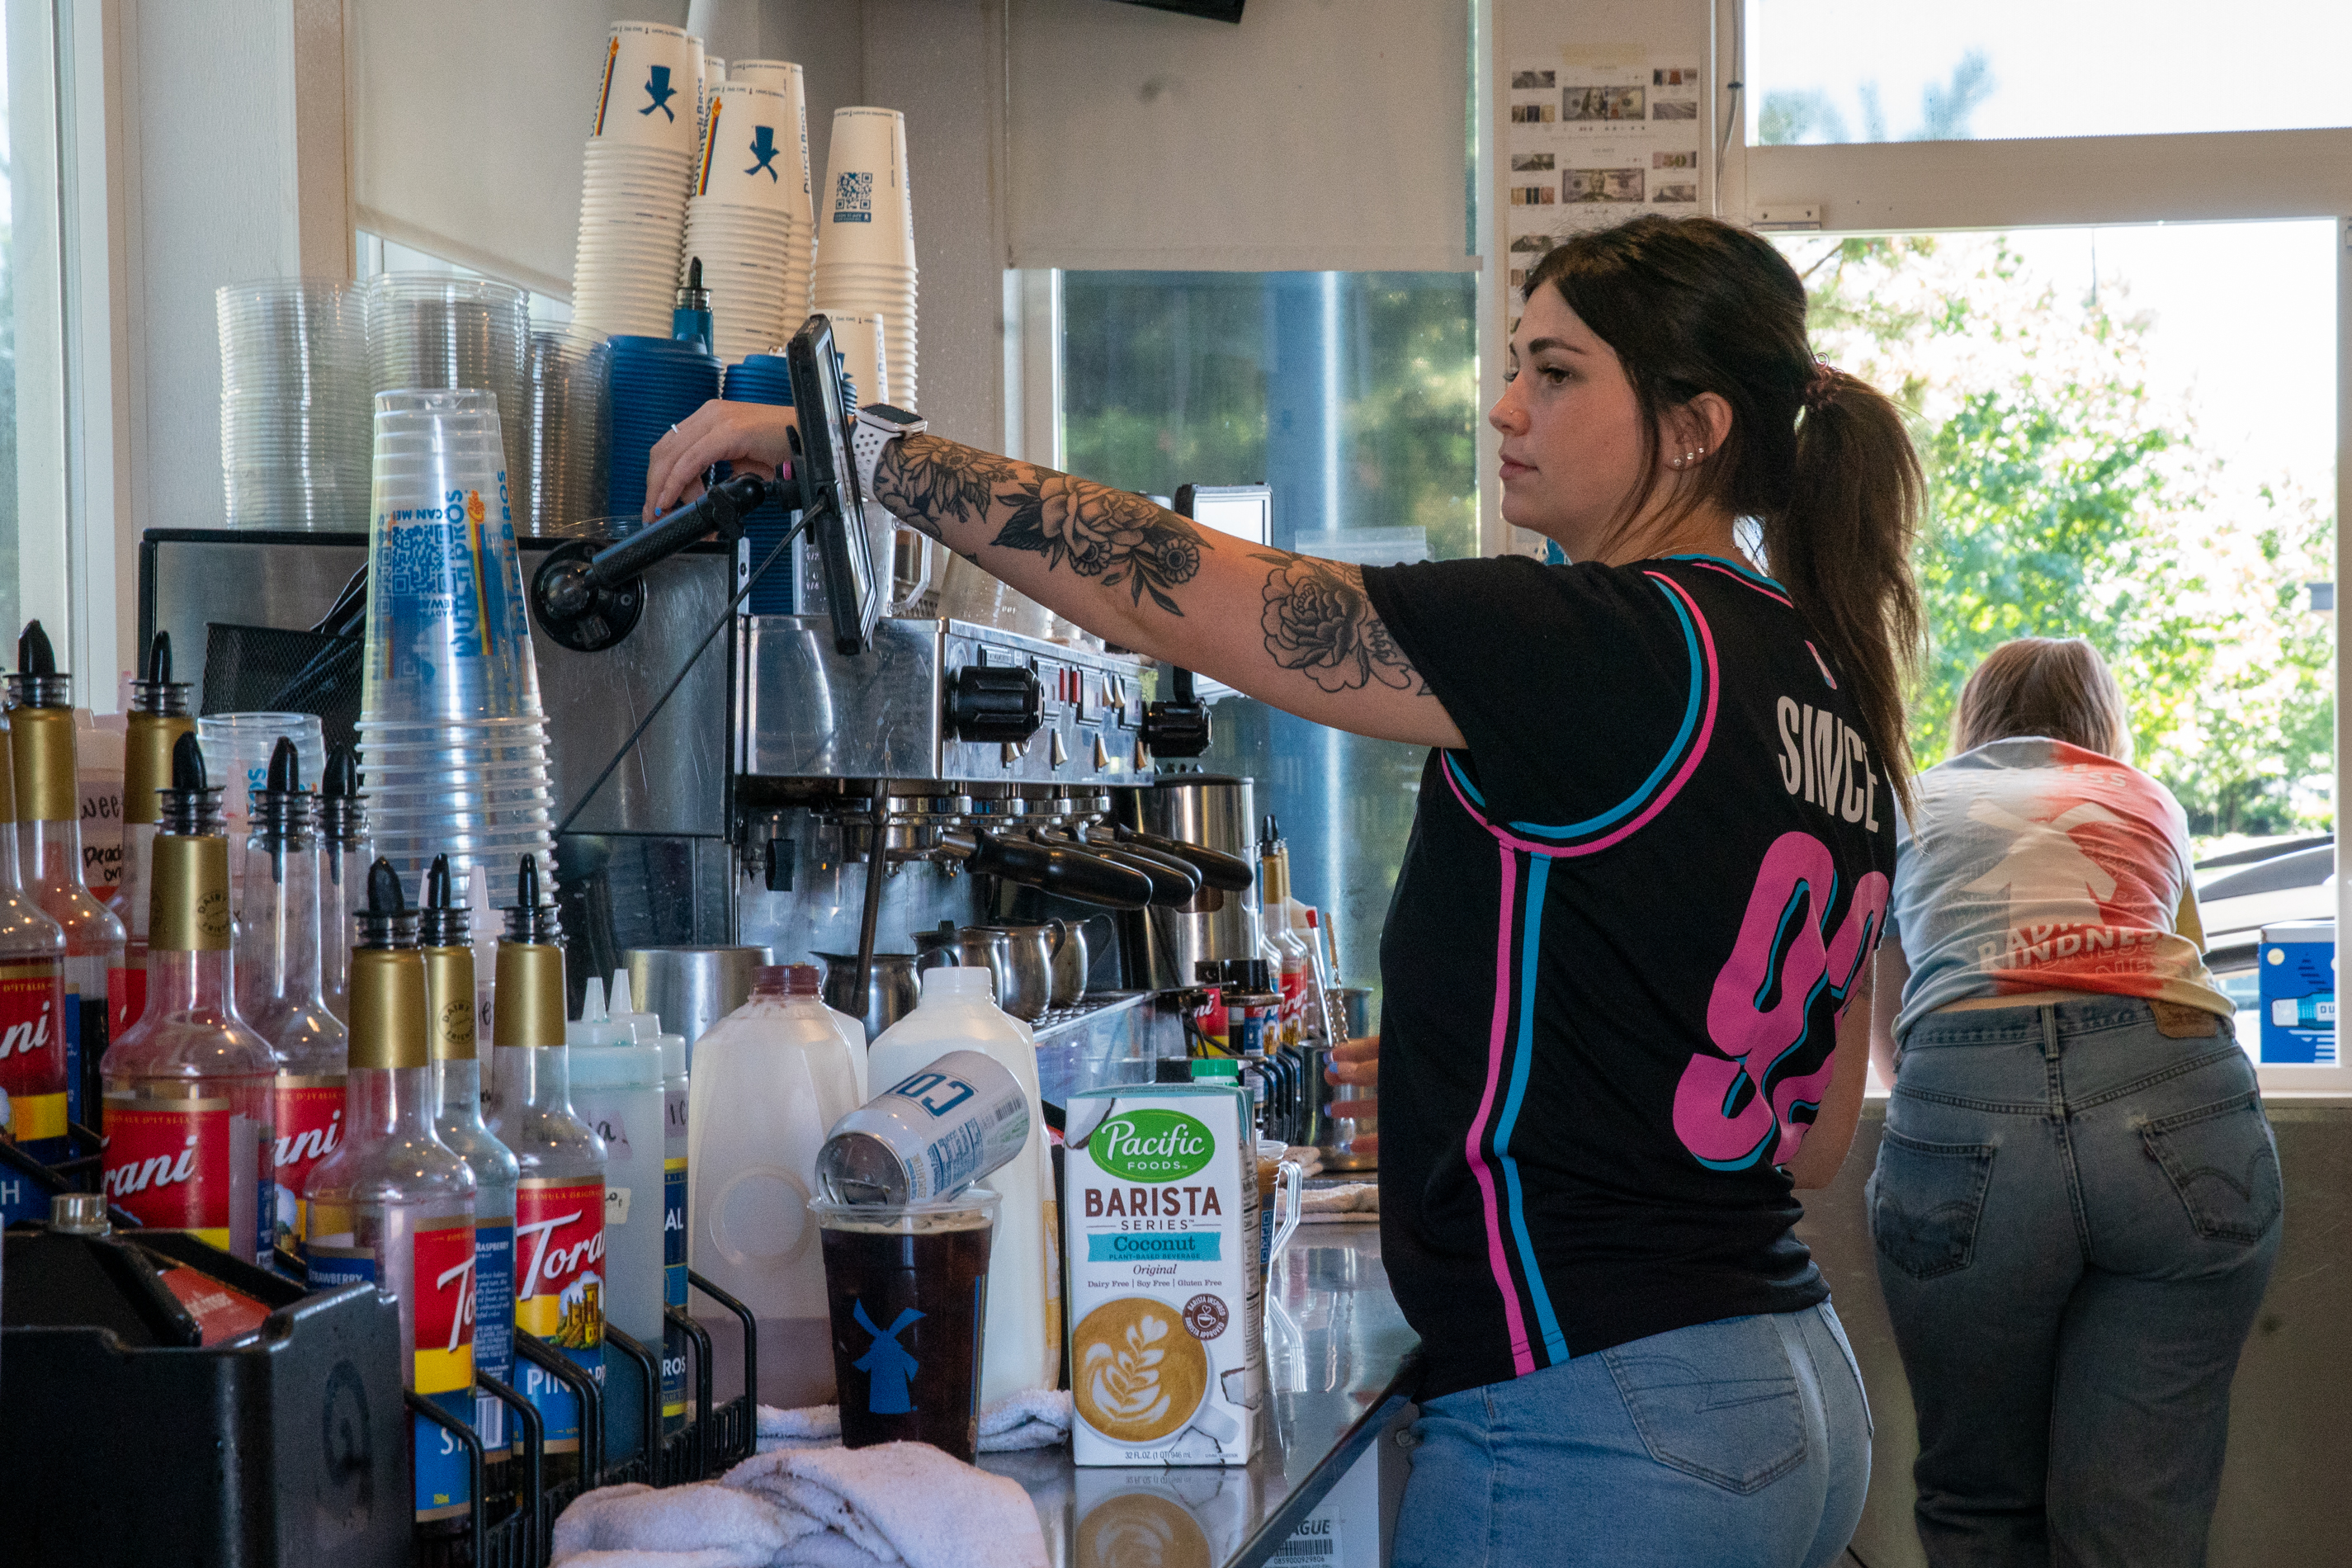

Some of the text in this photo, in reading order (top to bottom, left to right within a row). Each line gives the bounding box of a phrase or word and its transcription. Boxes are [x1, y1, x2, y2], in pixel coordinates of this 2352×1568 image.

[1777, 696, 1879, 834] SINCE
[1101, 1120, 1205, 1160] Pacific
[101, 1134, 197, 1197] rani
[1085, 1187, 1222, 1217] BARISTA
[1114, 1236, 1196, 1252] Coconut
[1132, 1264, 1178, 1277] Original
[1088, 1281, 1109, 1289] Dairy
[1136, 1280, 1150, 1288] Soy
[1153, 1279, 1170, 1287] Free
[1187, 1296, 1226, 1317] BARISTA INSPIRED
[1184, 1316, 1226, 1339] BARISTA APPROVED
